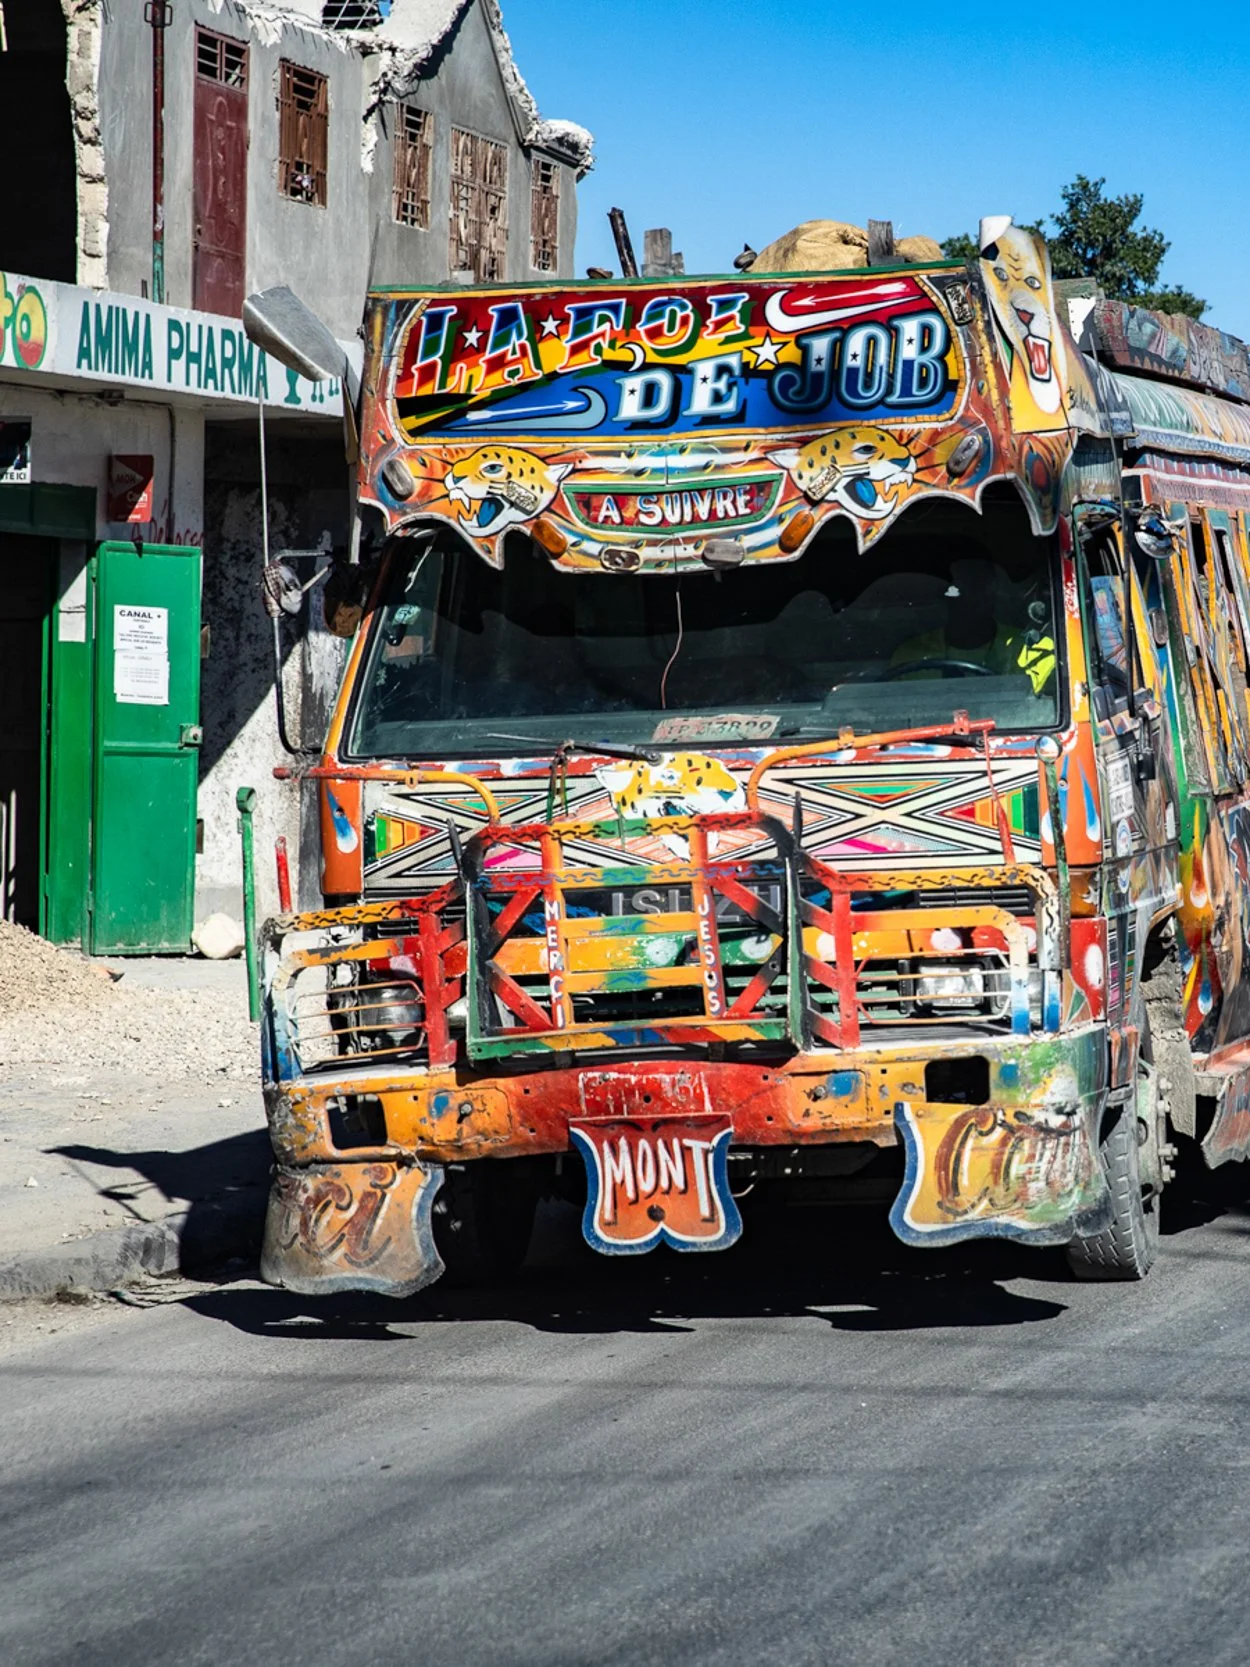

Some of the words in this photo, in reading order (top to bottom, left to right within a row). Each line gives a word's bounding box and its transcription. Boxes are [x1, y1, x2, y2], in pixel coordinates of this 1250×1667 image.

[76, 301, 153, 380] AMIMA
[166, 317, 268, 399] PHARMA
[612, 350, 745, 423] DE
[769, 312, 946, 409] JOB
[597, 495, 622, 525] A
[636, 485, 752, 526] SUIVRE
[119, 609, 153, 619] CANAL
[544, 898, 566, 1030] MERCI
[698, 893, 723, 1016] JESUS
[601, 1134, 717, 1226] MONT
